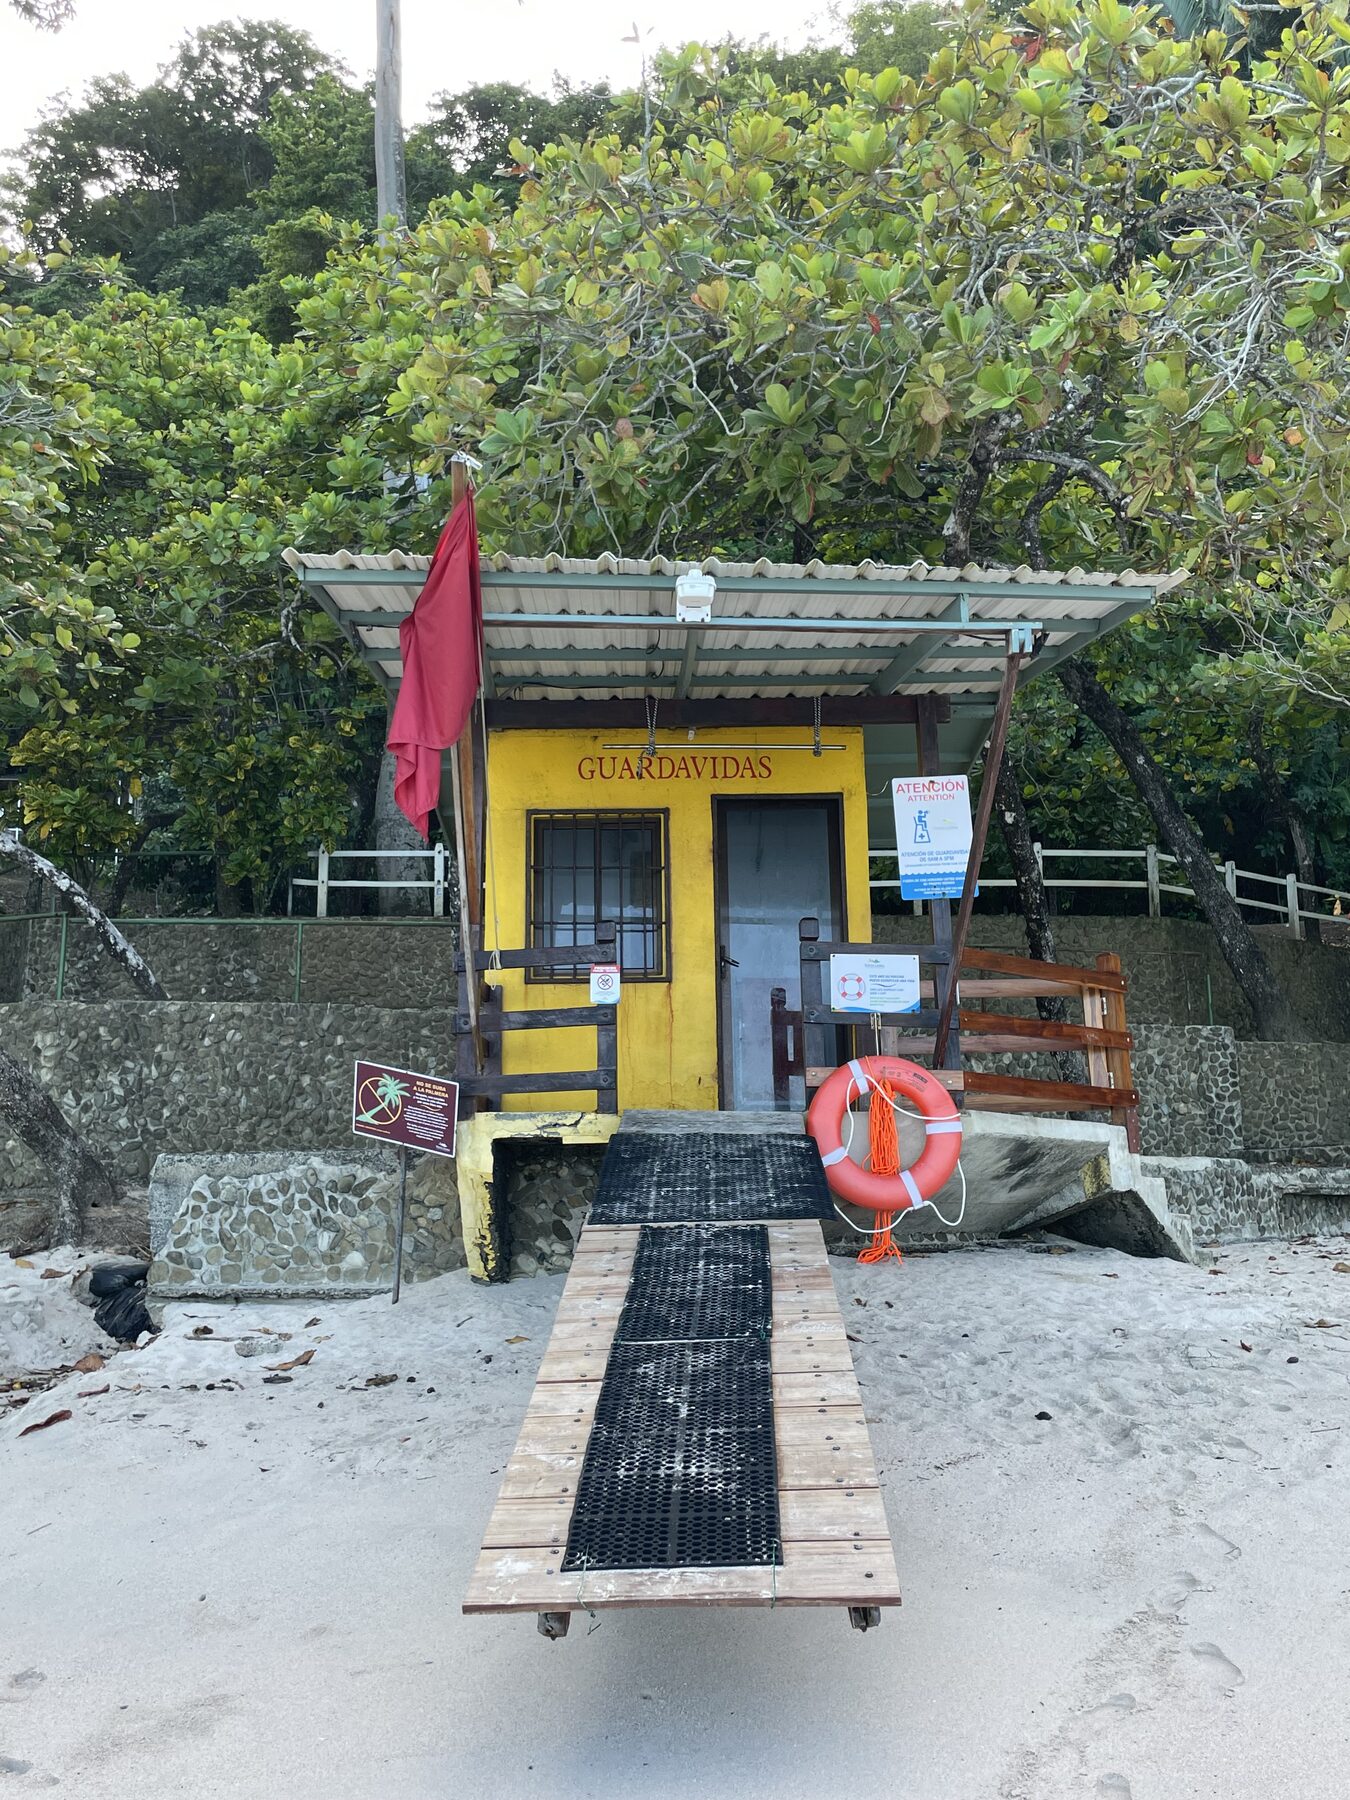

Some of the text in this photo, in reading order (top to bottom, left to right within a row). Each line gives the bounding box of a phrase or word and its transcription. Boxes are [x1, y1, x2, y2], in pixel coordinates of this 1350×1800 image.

[577, 755, 773, 780] GUARDAVIDAS
[896, 778, 965, 794] ATENCIÓN
[907, 793, 955, 802] ATTENTION
[425, 1088, 448, 1098] PALMERA
